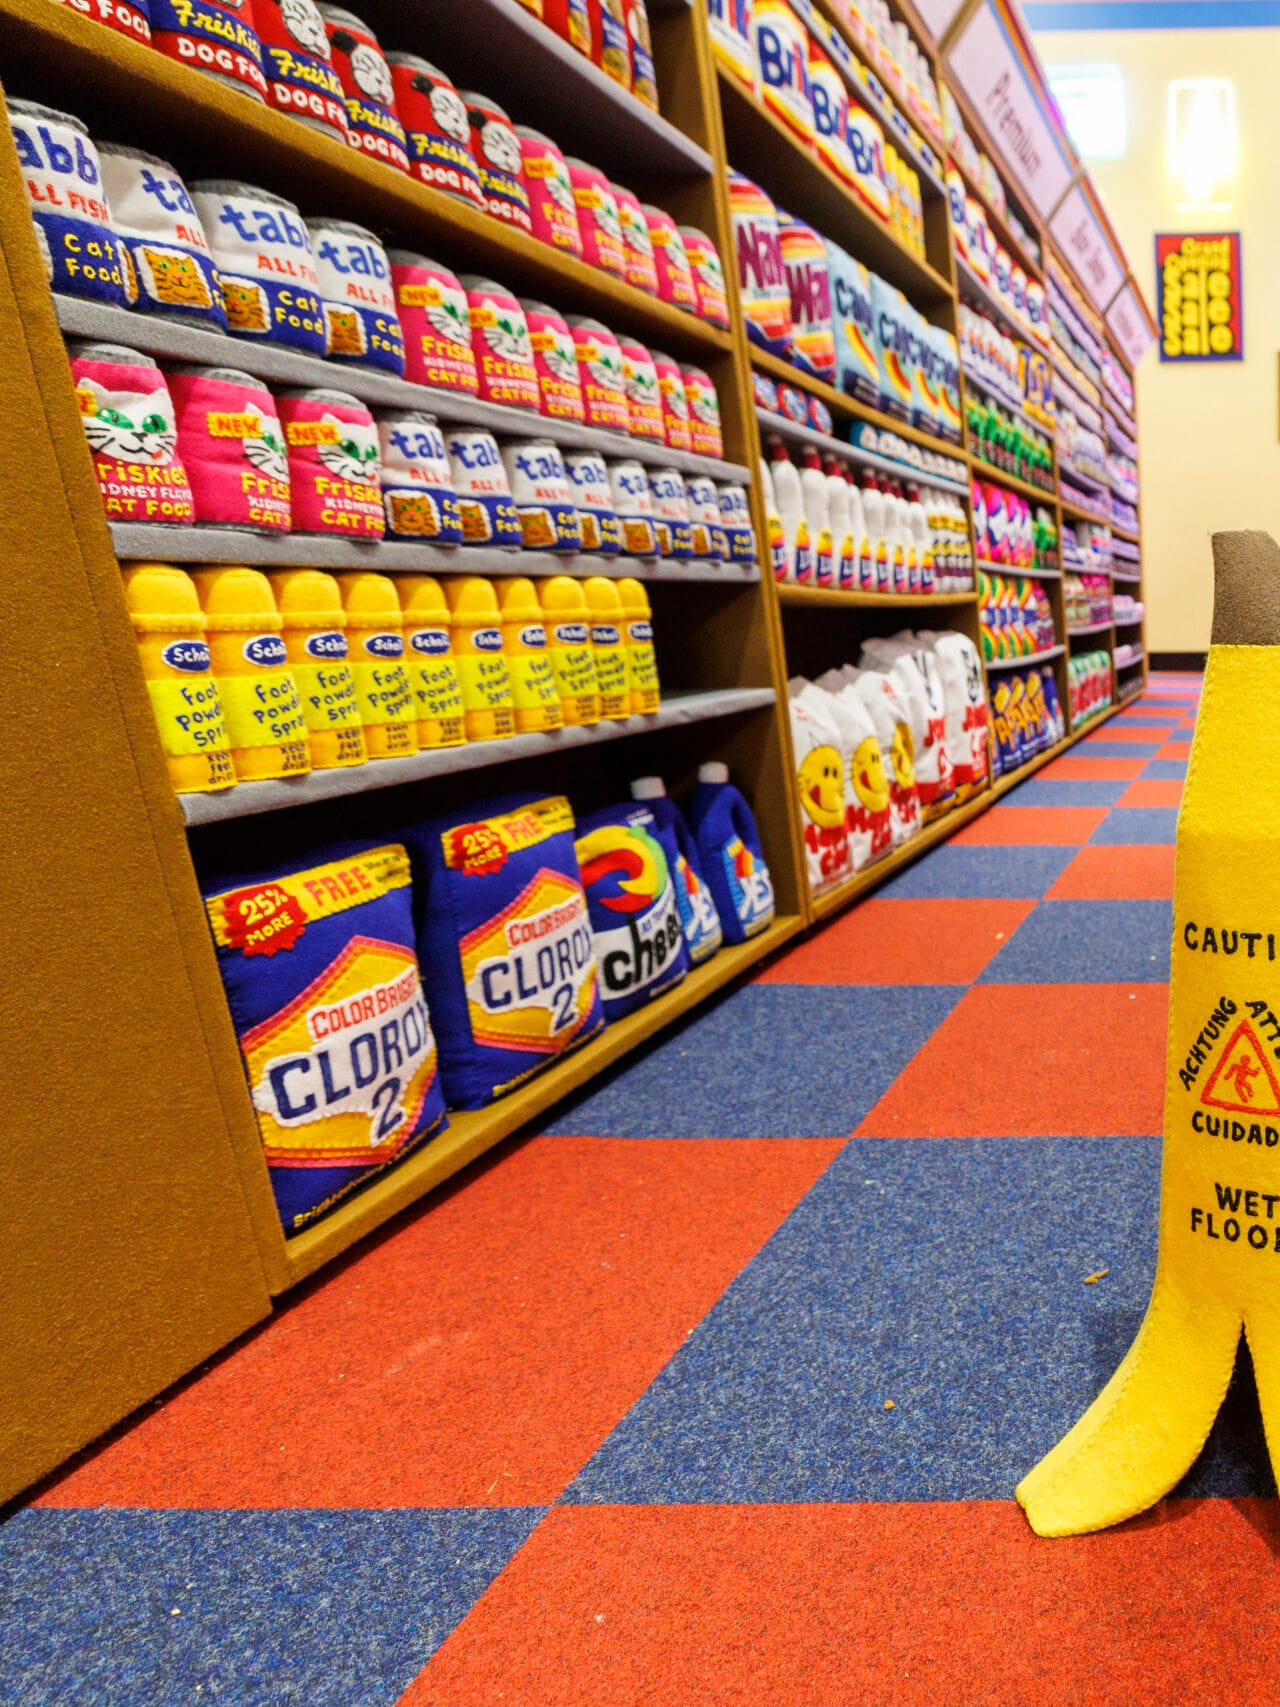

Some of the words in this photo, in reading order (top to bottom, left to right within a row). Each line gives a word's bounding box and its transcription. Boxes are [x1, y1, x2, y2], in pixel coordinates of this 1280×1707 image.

[177, 37, 233, 70] DOG
[273, 83, 324, 115] DOG
[348, 130, 392, 157] DOG
[420, 163, 462, 194] DOG
[28, 180, 56, 206] LL
[65, 258, 122, 285] Food
[257, 253, 297, 277] ALL
[346, 283, 378, 303] ALL
[274, 306, 324, 335] Food
[217, 417, 258, 434] NEW
[292, 426, 339, 444] NEW
[100, 484, 155, 500] IDNEY
[146, 500, 192, 517] FOOD
[249, 507, 284, 526] CAT
[320, 510, 361, 531] CAT
[173, 647, 210, 663] Scho
[239, 888, 289, 925] 25%
[303, 866, 373, 908] FREE
[247, 913, 294, 946] MORE
[551, 983, 576, 1031] 2
[1178, 996, 1237, 1092] ACHTUNG
[371, 1077, 404, 1138] 2
[1213, 1182, 1280, 1219] WET
